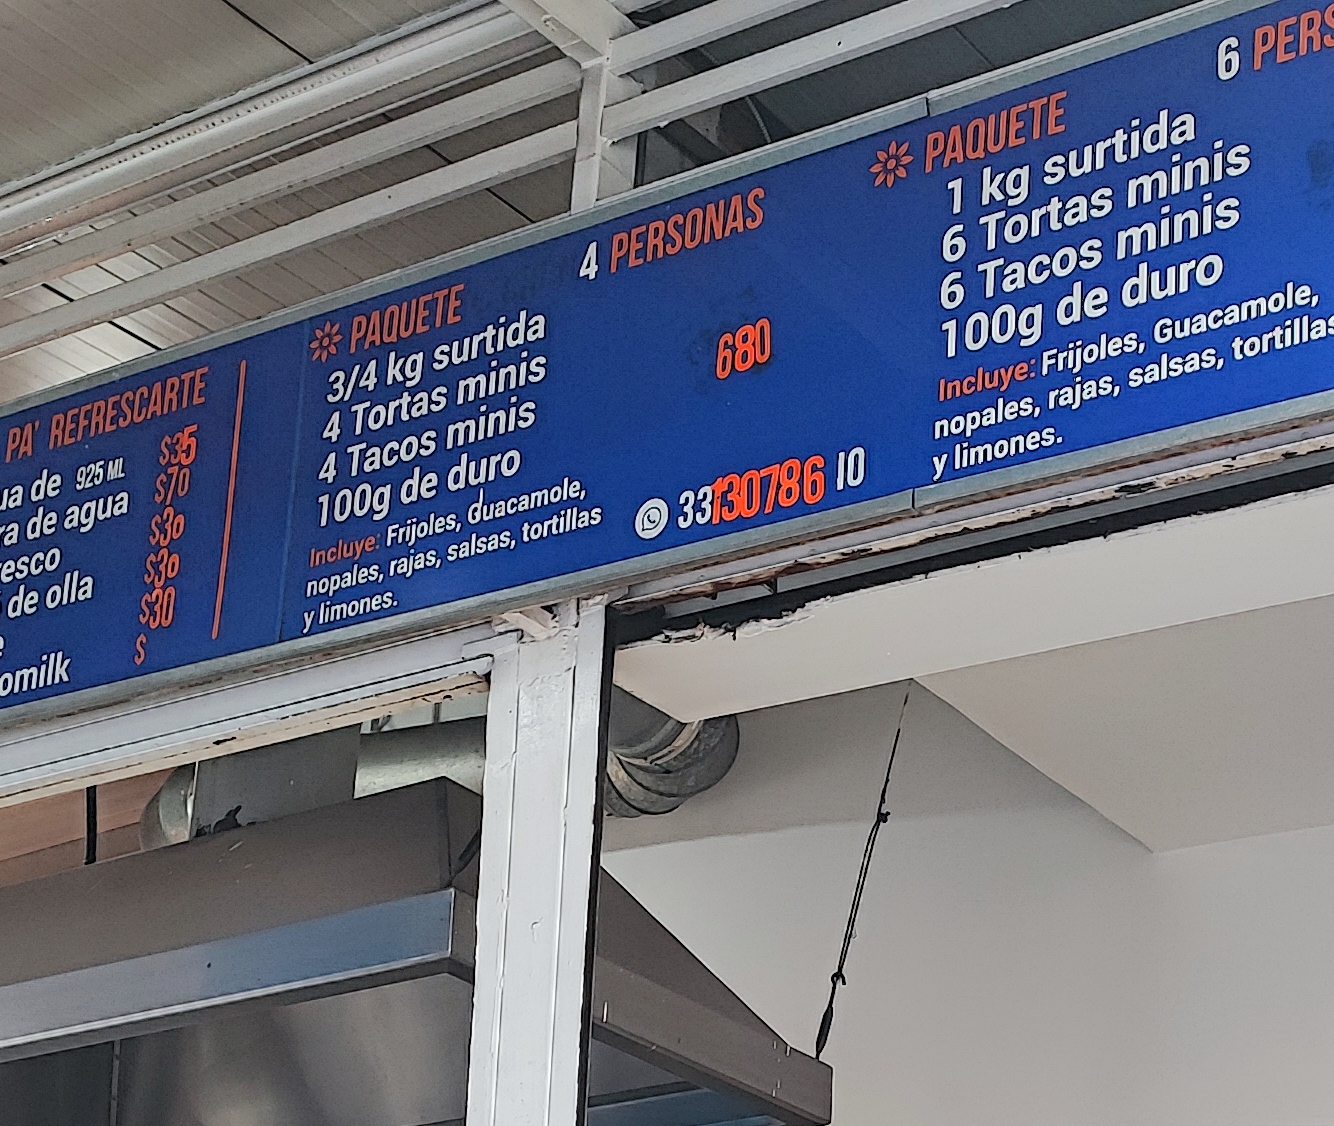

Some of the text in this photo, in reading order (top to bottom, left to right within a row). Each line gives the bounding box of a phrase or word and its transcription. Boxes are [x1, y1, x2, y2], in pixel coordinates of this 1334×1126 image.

[923, 89, 1068, 174] PAQUETE
[1215, 35, 1241, 82] 6
[941, 139, 1252, 264] 6 Tortas minis
[946, 108, 1197, 215] 1 kg surtida
[349, 187, 767, 354] PAQUETE 4 PERSONAS
[939, 191, 1241, 311] 6 Tacos minis
[715, 317, 772, 380] 680
[937, 280, 1321, 403] Incluye: Frijoles, Guacamole,
[940, 252, 1226, 359] 100g de duro
[322, 350, 548, 443] 4 Tortas minis
[326, 309, 548, 404] 3/4 kg surtida
[933, 395, 1042, 440] nopales,
[1047, 373, 1121, 411] rajas,
[1127, 346, 1225, 390] salsas,
[49, 365, 210, 451] REFRESCARTE
[318, 396, 537, 485] 4 Tacos minis
[30, 468, 62, 500] de
[75, 464, 104, 492] 925
[106, 457, 126, 483] ML
[159, 423, 199, 467] $35
[317, 448, 522, 528] 100g de duro
[835, 445, 866, 492] 10
[931, 424, 1064, 482] y limones.
[26, 507, 58, 540] de
[63, 490, 130, 535] agua
[154, 465, 191, 506] $70
[149, 505, 186, 548] $30
[308, 532, 382, 569] Incluye:
[385, 511, 463, 550] Frijoles,
[7, 583, 40, 617] de
[45, 570, 95, 609] olla
[143, 546, 181, 590] $30
[305, 504, 604, 599] nopales, rajas, salsas, tortillas
[138, 585, 177, 630] $30
[301, 589, 399, 635] y limones.
